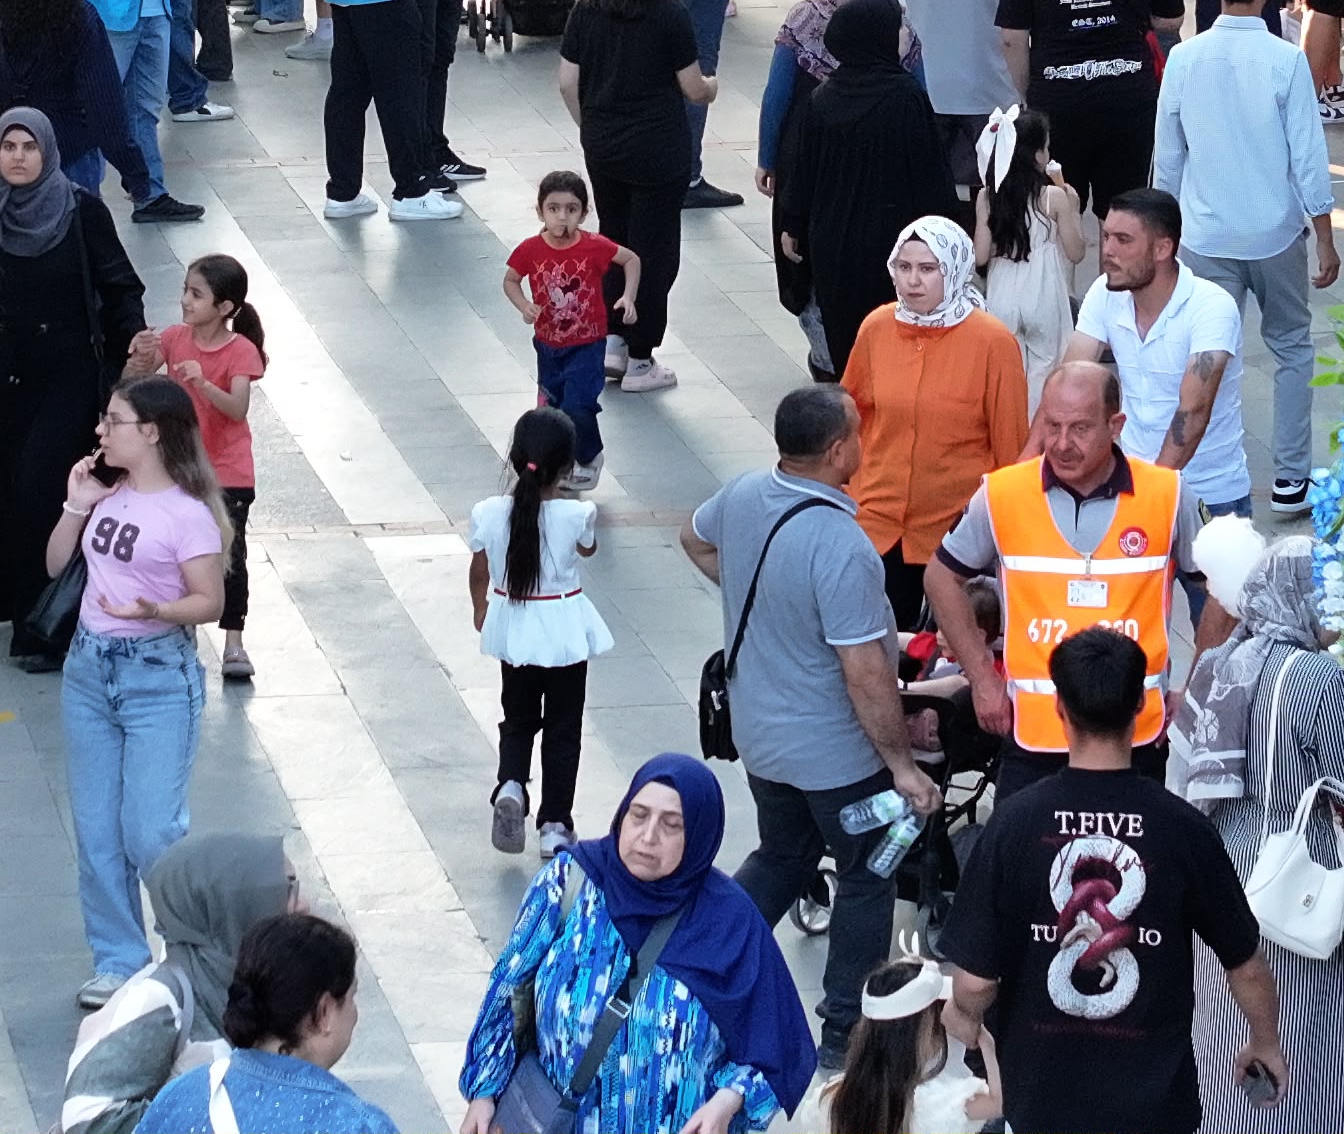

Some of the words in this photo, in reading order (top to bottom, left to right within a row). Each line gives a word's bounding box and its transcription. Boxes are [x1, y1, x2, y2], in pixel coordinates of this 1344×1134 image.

[91, 516, 141, 563] 98
[1027, 618, 1069, 644] 672
[1054, 811, 1144, 837] T.FIVE
